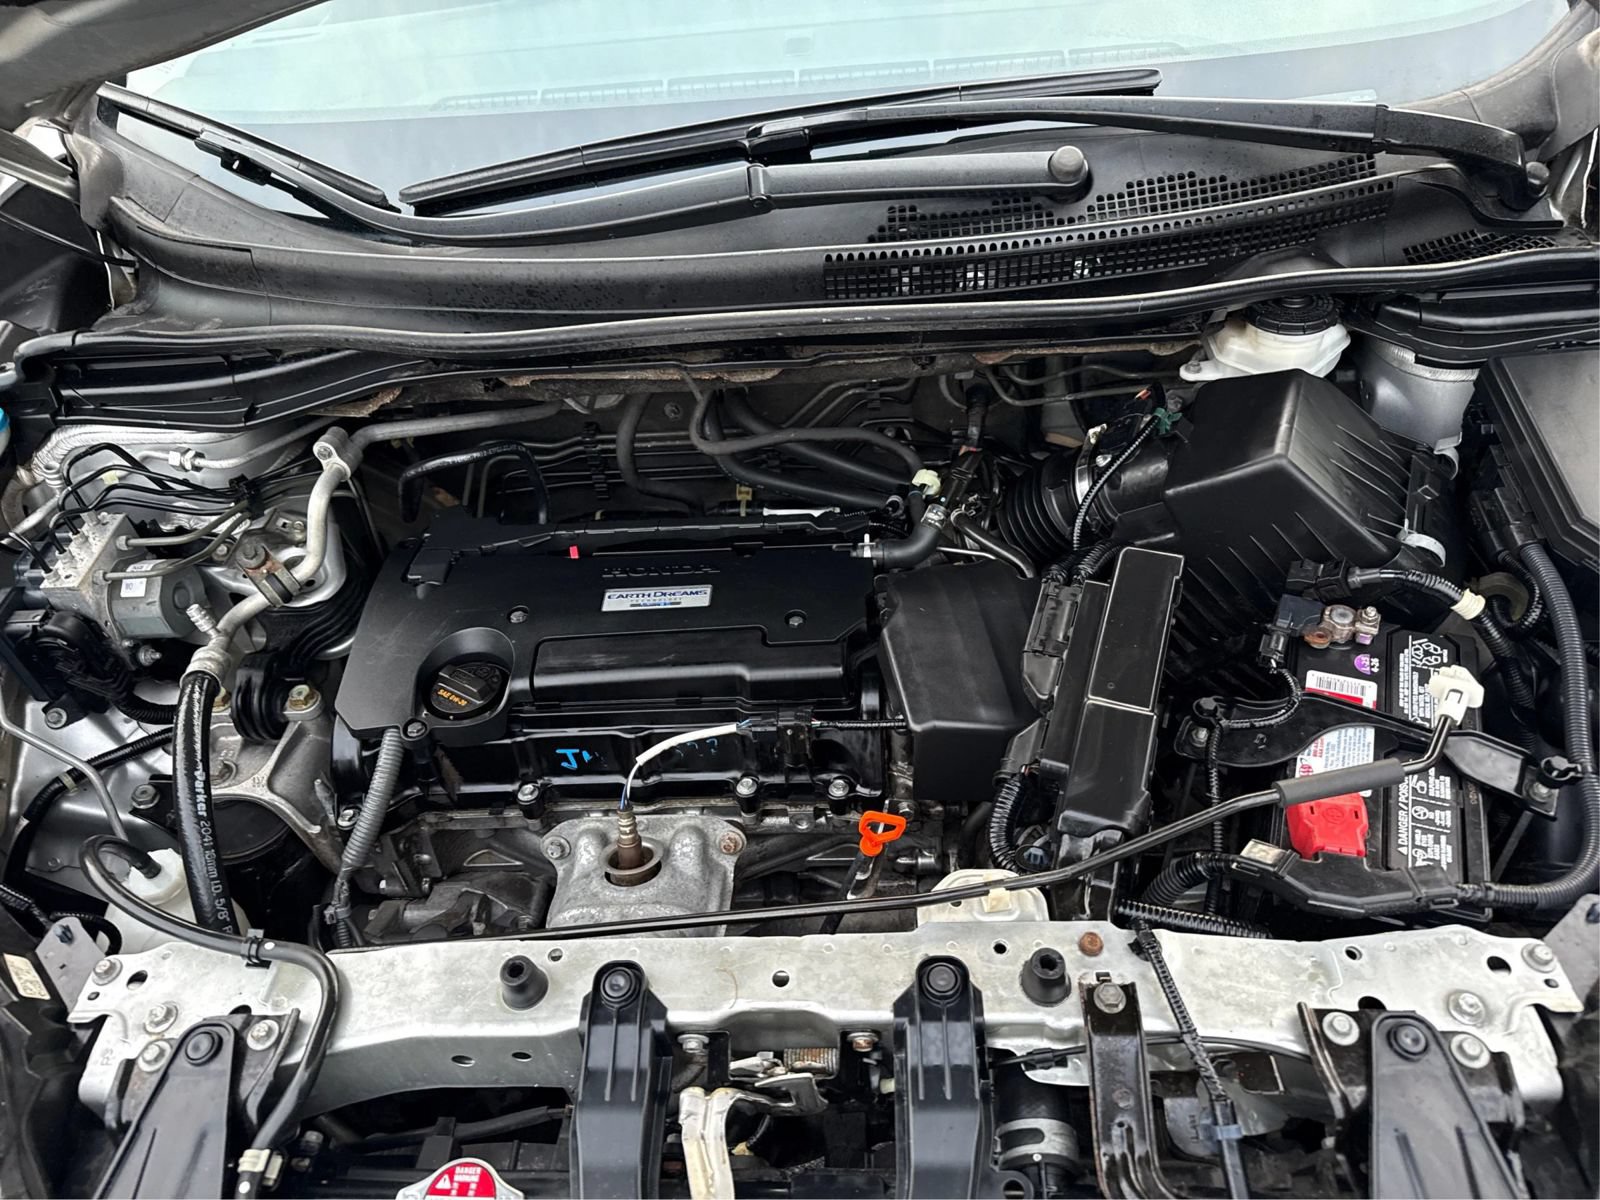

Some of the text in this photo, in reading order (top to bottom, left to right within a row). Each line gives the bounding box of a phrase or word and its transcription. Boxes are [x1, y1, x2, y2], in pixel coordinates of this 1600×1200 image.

[602, 565, 720, 578] HONDA
[607, 589, 708, 600] EARTH DREAMS
[194, 771, 208, 817] Parker
